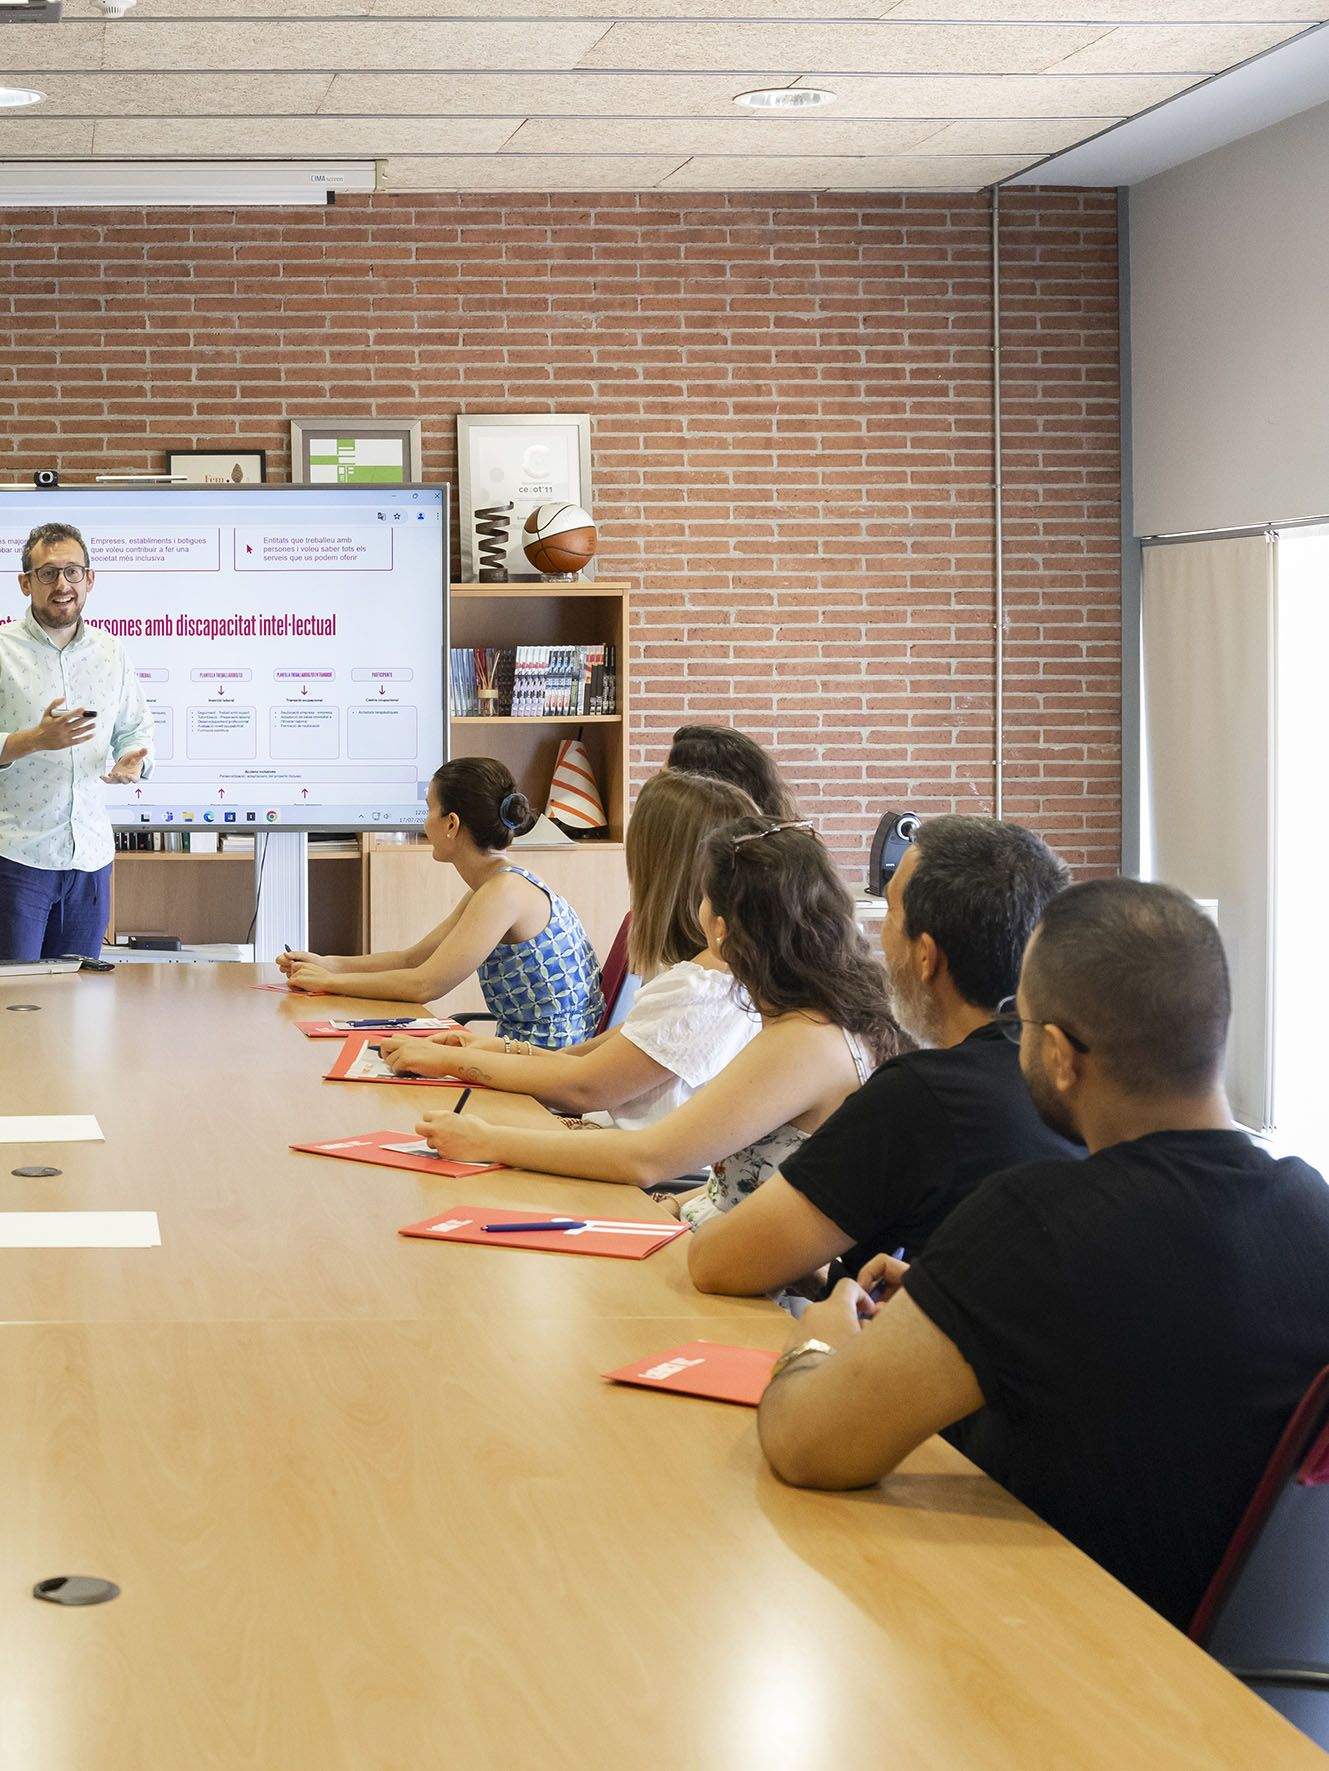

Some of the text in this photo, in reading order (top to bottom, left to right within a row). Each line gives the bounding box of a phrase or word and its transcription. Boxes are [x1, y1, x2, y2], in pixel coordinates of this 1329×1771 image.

[263, 536, 289, 544] Entitats
[336, 536, 352, 544] amb
[263, 546, 296, 554] persones
[314, 554, 338, 562] podem
[145, 614, 172, 636] amb
[176, 614, 257, 640] discapacitat
[259, 613, 336, 636] intel·lectual
